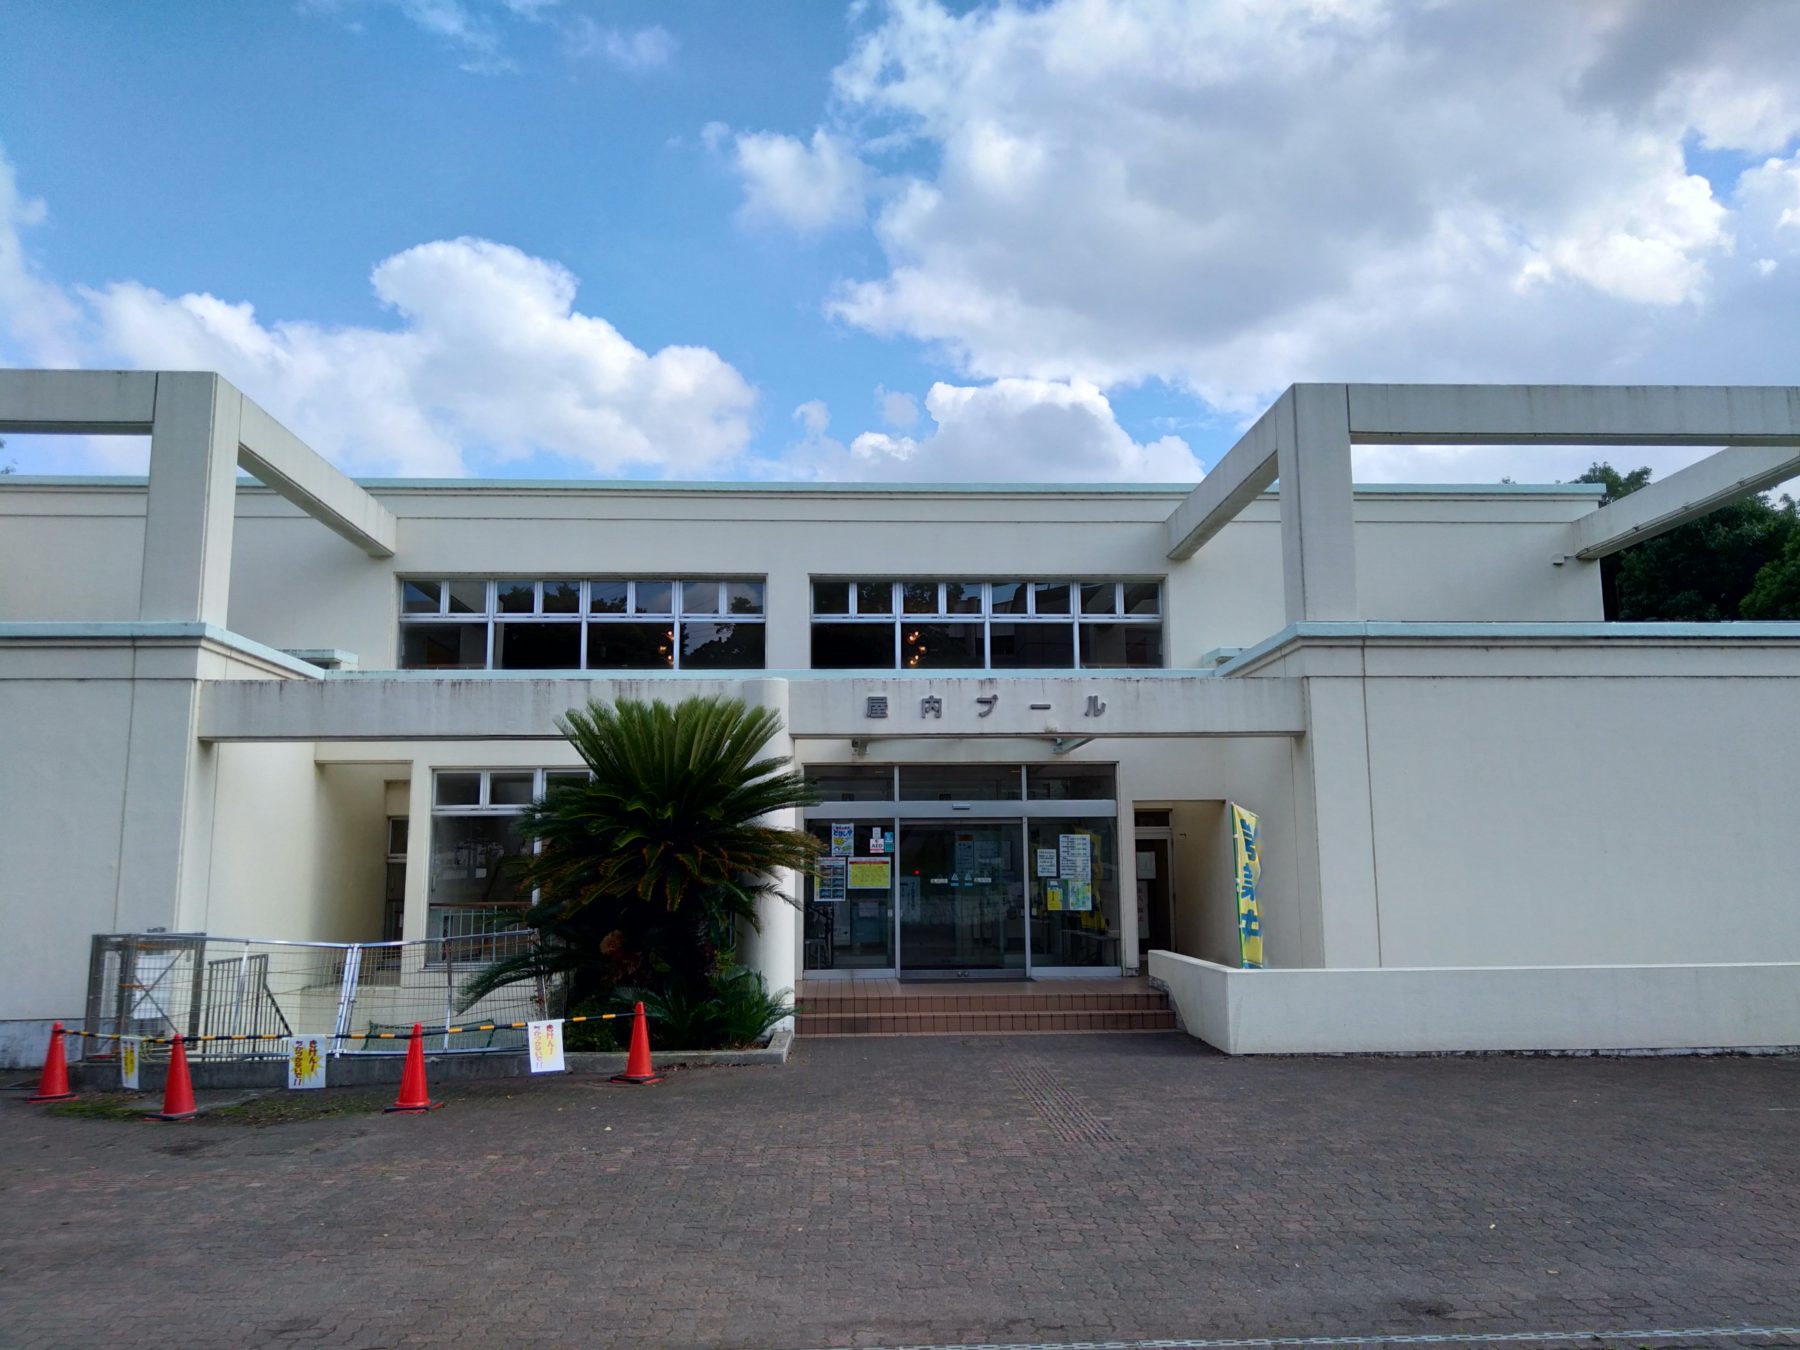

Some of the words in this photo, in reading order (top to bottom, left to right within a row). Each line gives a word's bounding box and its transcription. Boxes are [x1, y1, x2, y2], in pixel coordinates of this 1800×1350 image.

[866, 695, 1107, 719] 屋内プール
